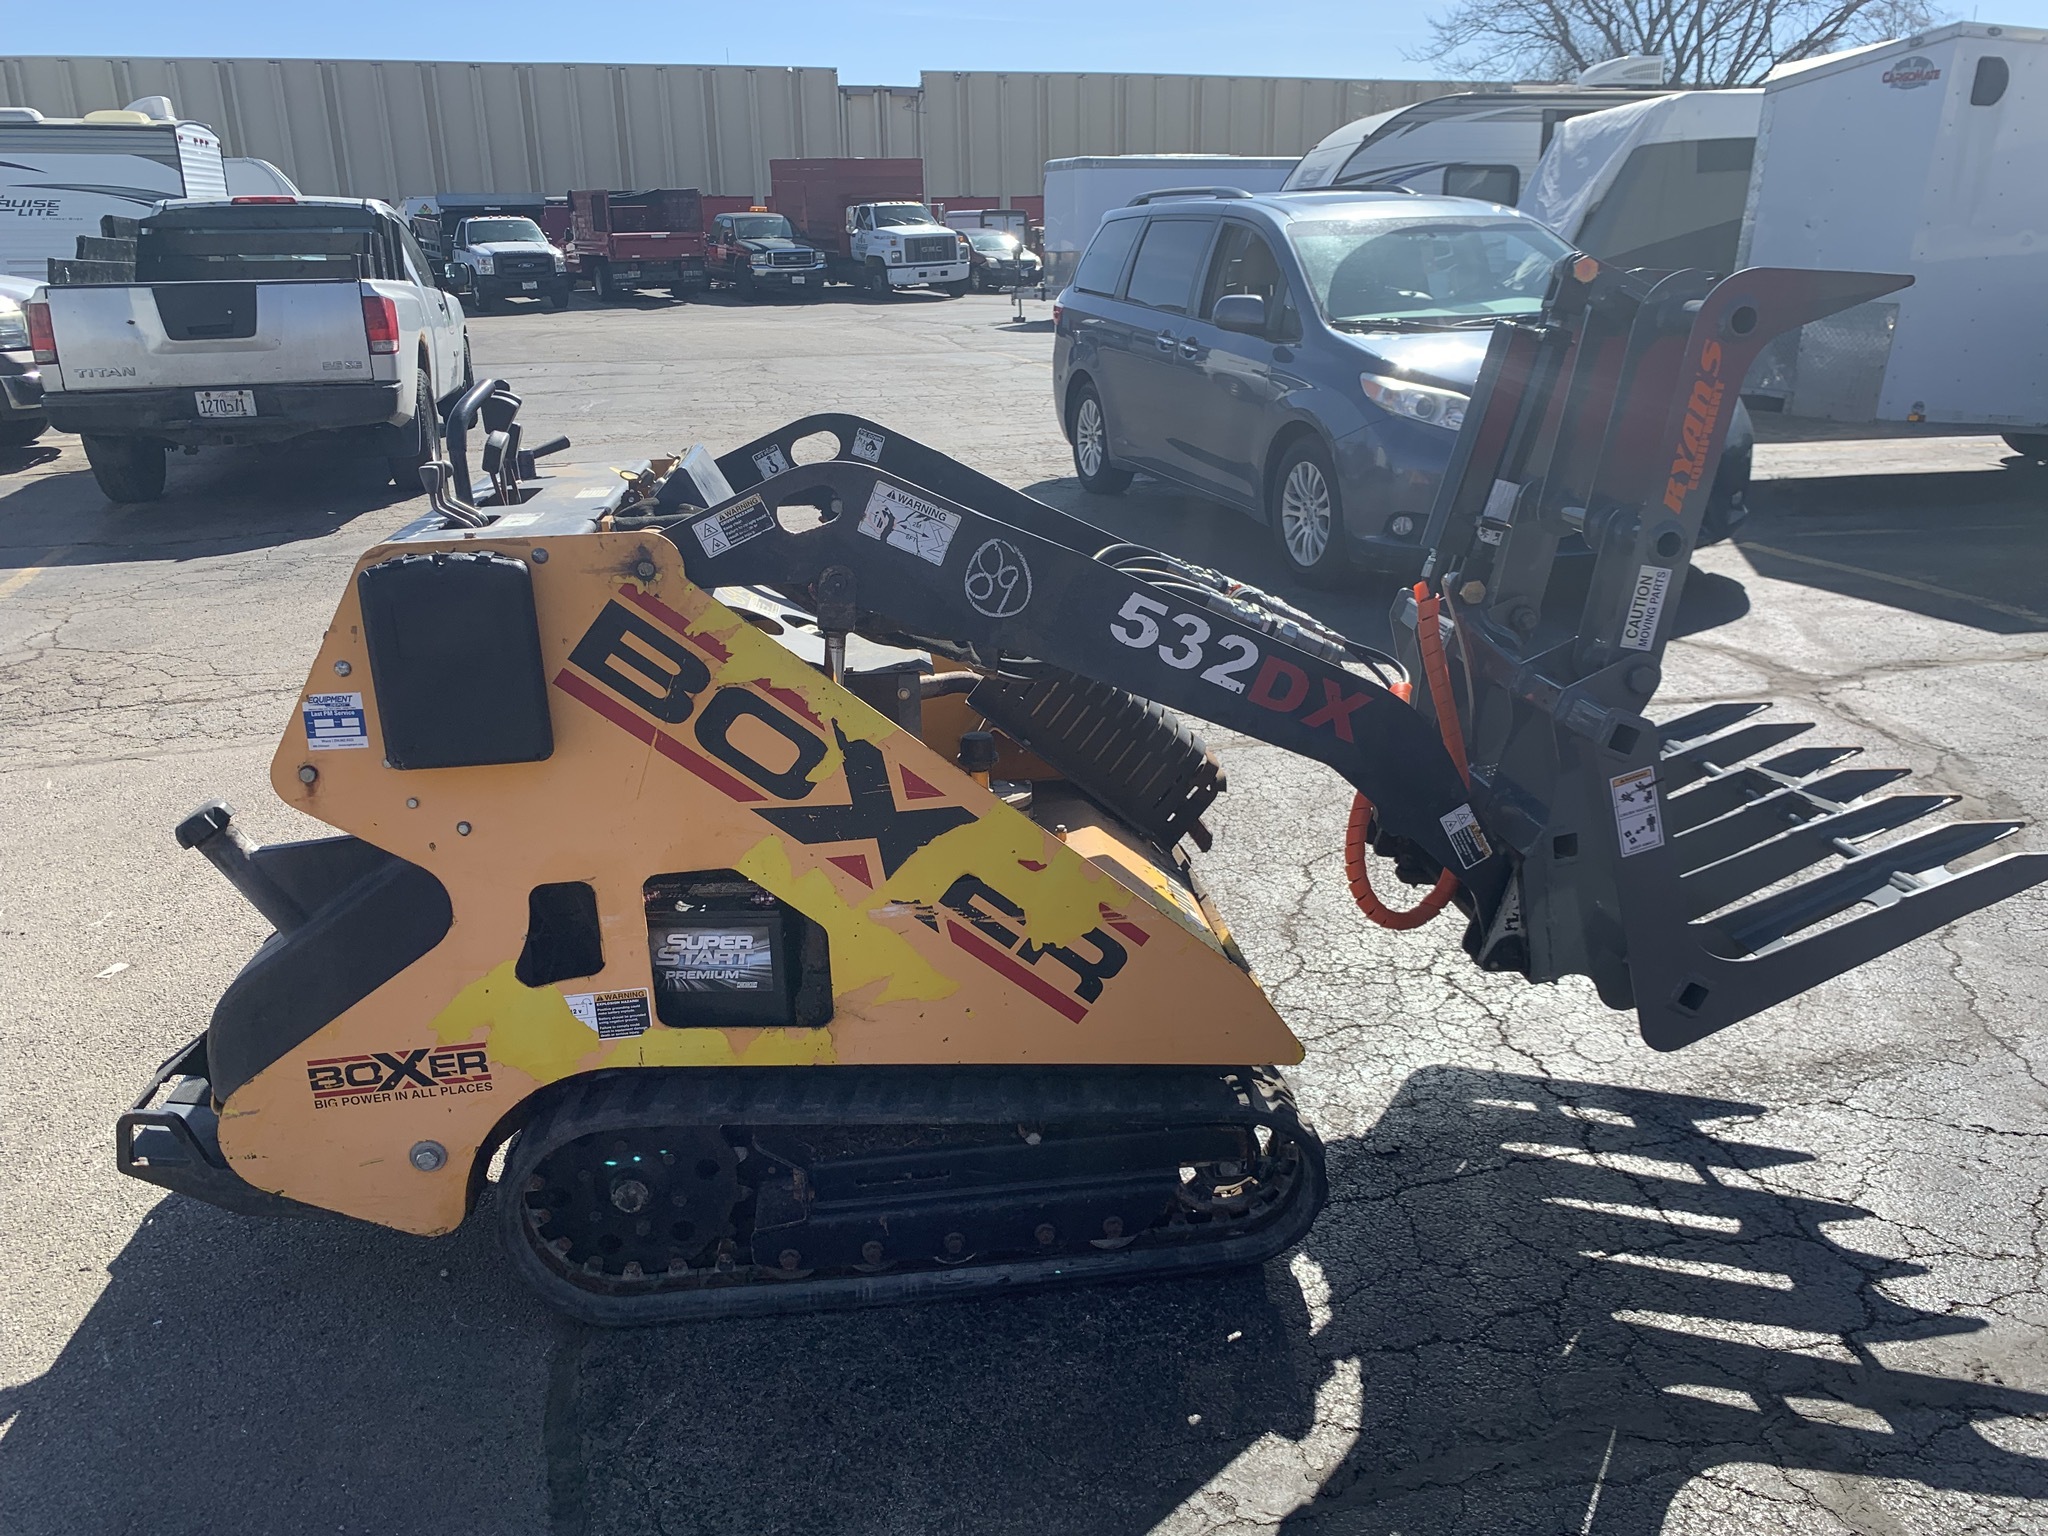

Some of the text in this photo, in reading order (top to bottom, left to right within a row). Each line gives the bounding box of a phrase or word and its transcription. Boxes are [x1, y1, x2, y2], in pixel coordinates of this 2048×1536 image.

[0, 199, 61, 208] RUISE
[18, 208, 59, 217] LITE
[921, 245, 943, 253] GMC
[74, 366, 136, 379] TITAN
[724, 497, 759, 517] WARNING
[898, 493, 947, 522] WARNING
[1625, 575, 1654, 639] CAUTION
[1638, 571, 1666, 647] MOVING PARTS
[308, 695, 353, 704] EQUIPMENT
[666, 934, 754, 950] SUPER
[656, 946, 754, 966] START
[665, 970, 740, 980] PREMIUM
[604, 990, 645, 1001] WARNING
[307, 1048, 489, 1092] BOXER
[314, 1082, 493, 1110] BIG POWER IN ALL PLACES
